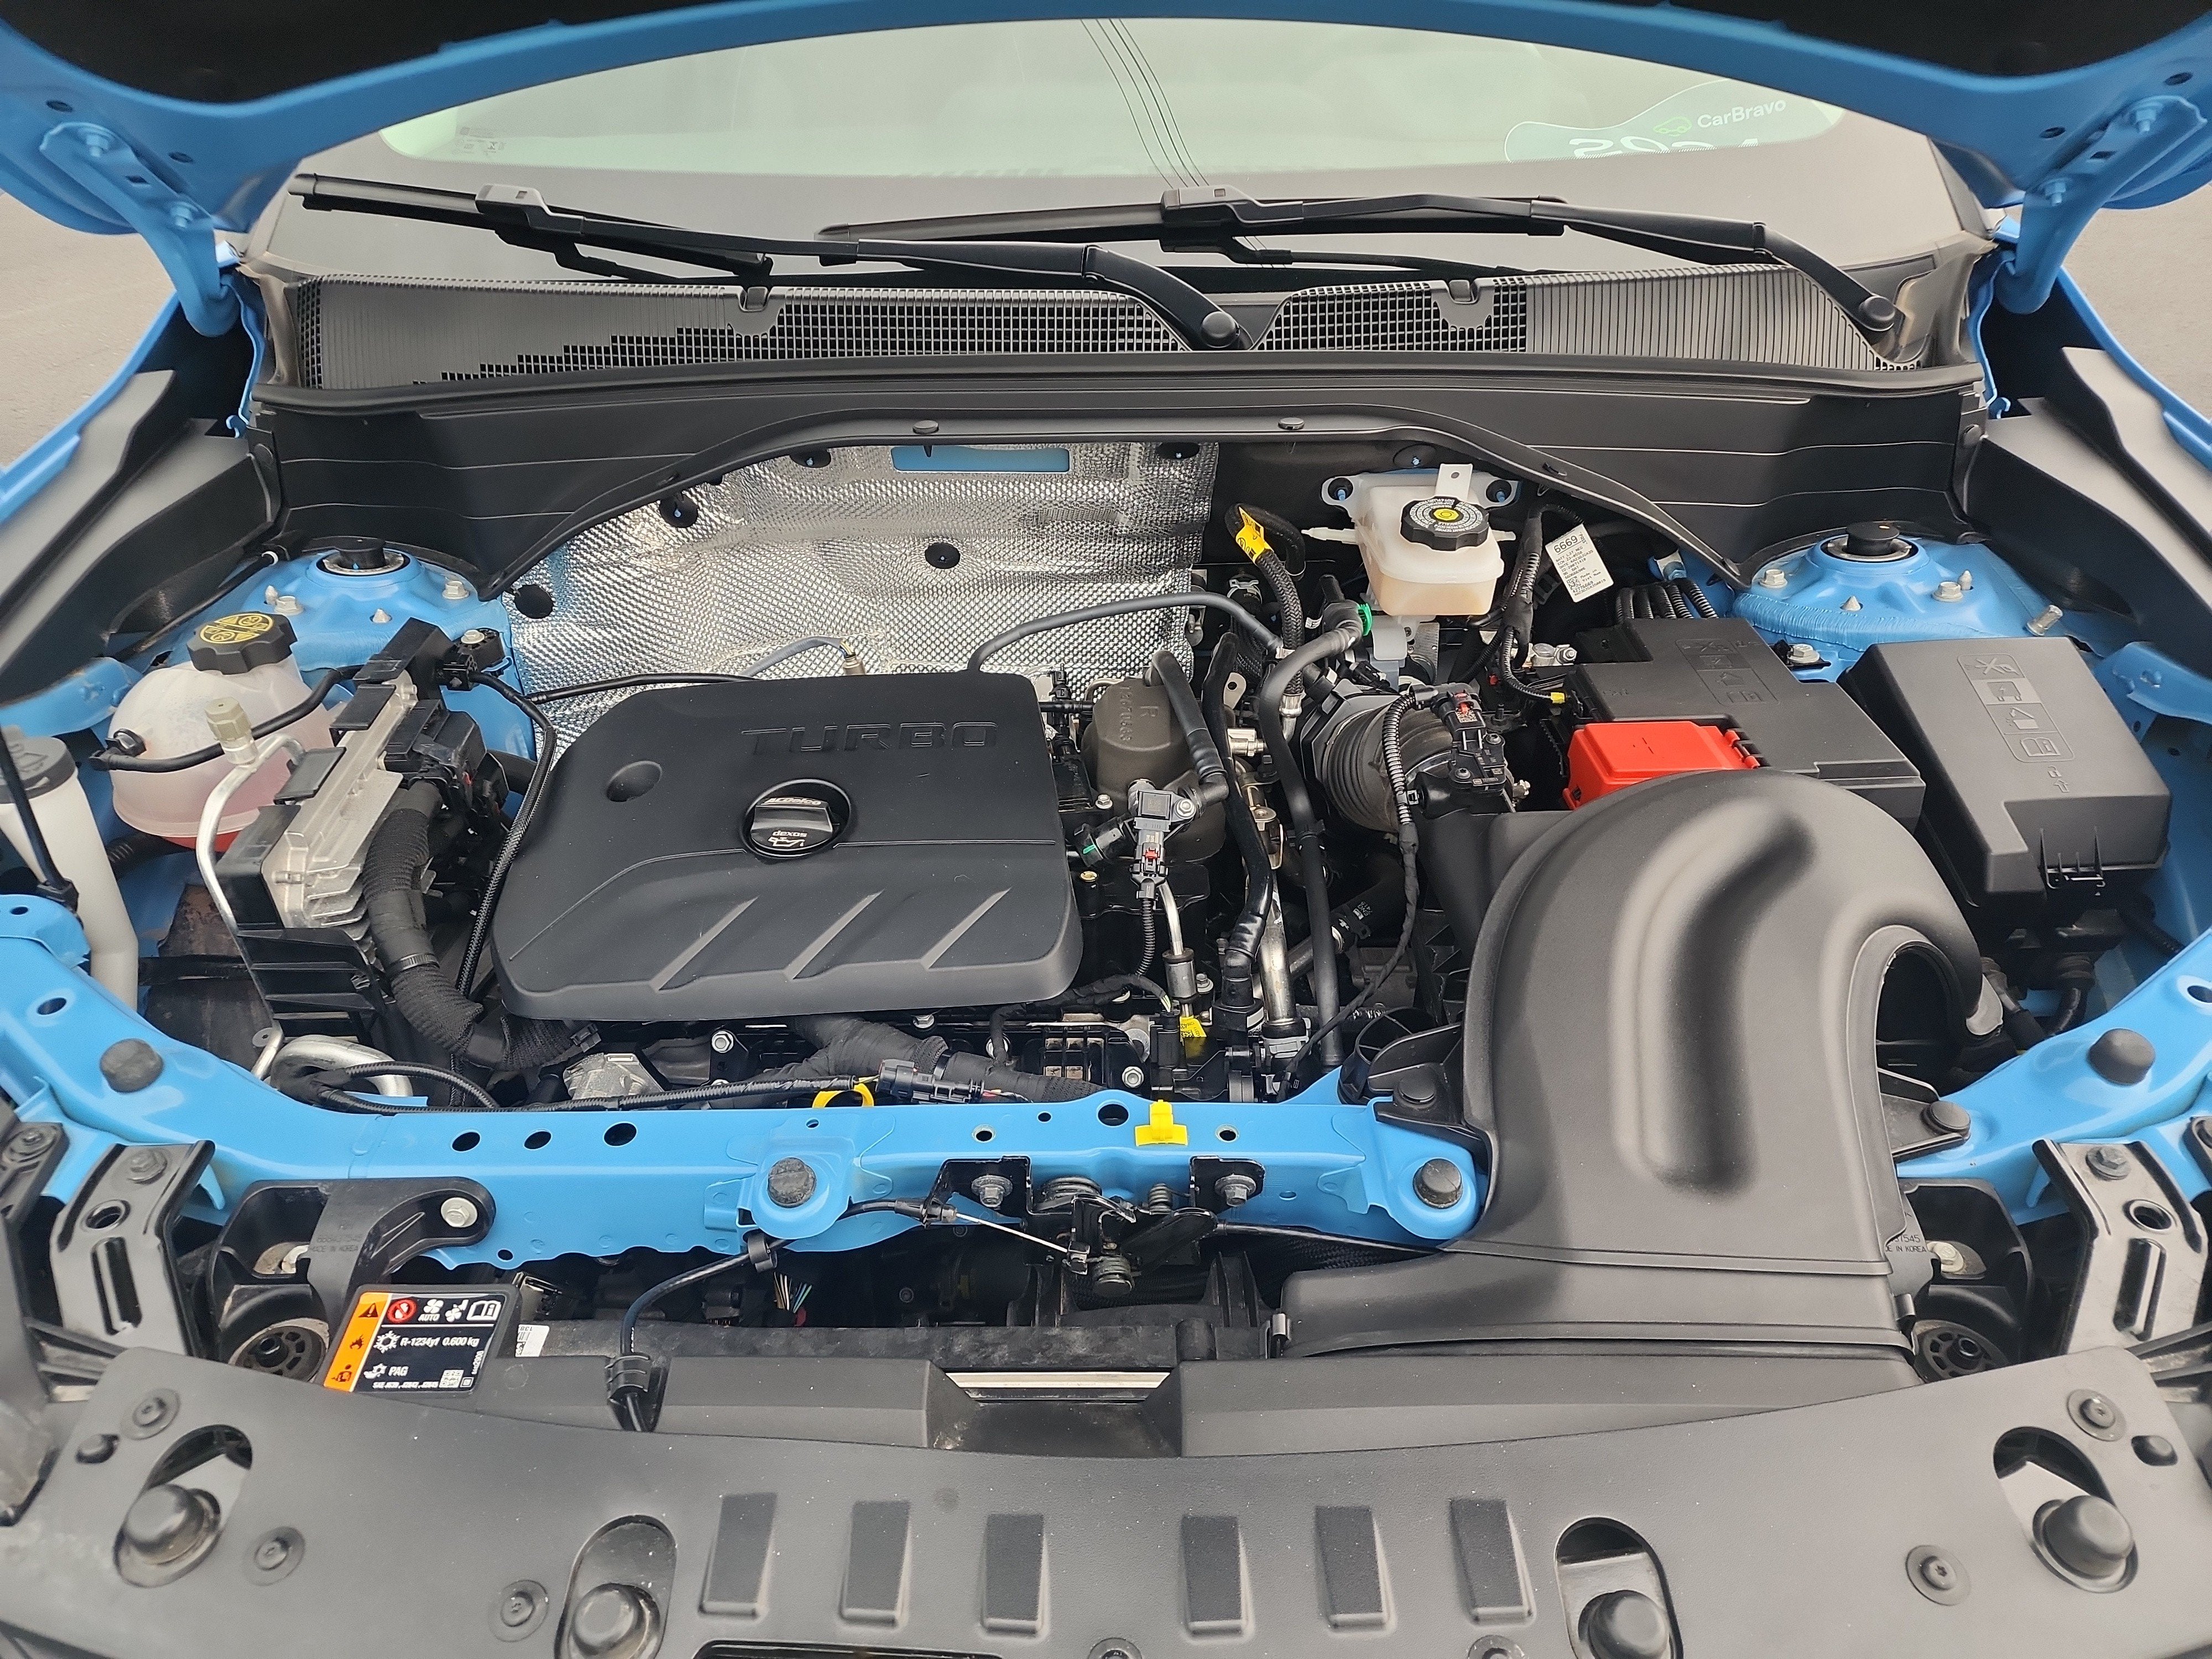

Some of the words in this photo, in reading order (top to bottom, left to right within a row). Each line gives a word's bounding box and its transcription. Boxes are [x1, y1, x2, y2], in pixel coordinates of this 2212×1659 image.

[1698, 100, 1786, 128] CarBravo
[1554, 535, 1578, 553] 6669
[741, 722, 998, 754] TURBO
[763, 797, 822, 806] ACDelco
[418, 1313, 440, 1322] AUTO
[442, 1336, 469, 1347] 0.600
[468, 1337, 480, 1348] kg
[388, 1366, 410, 1376] PAG
